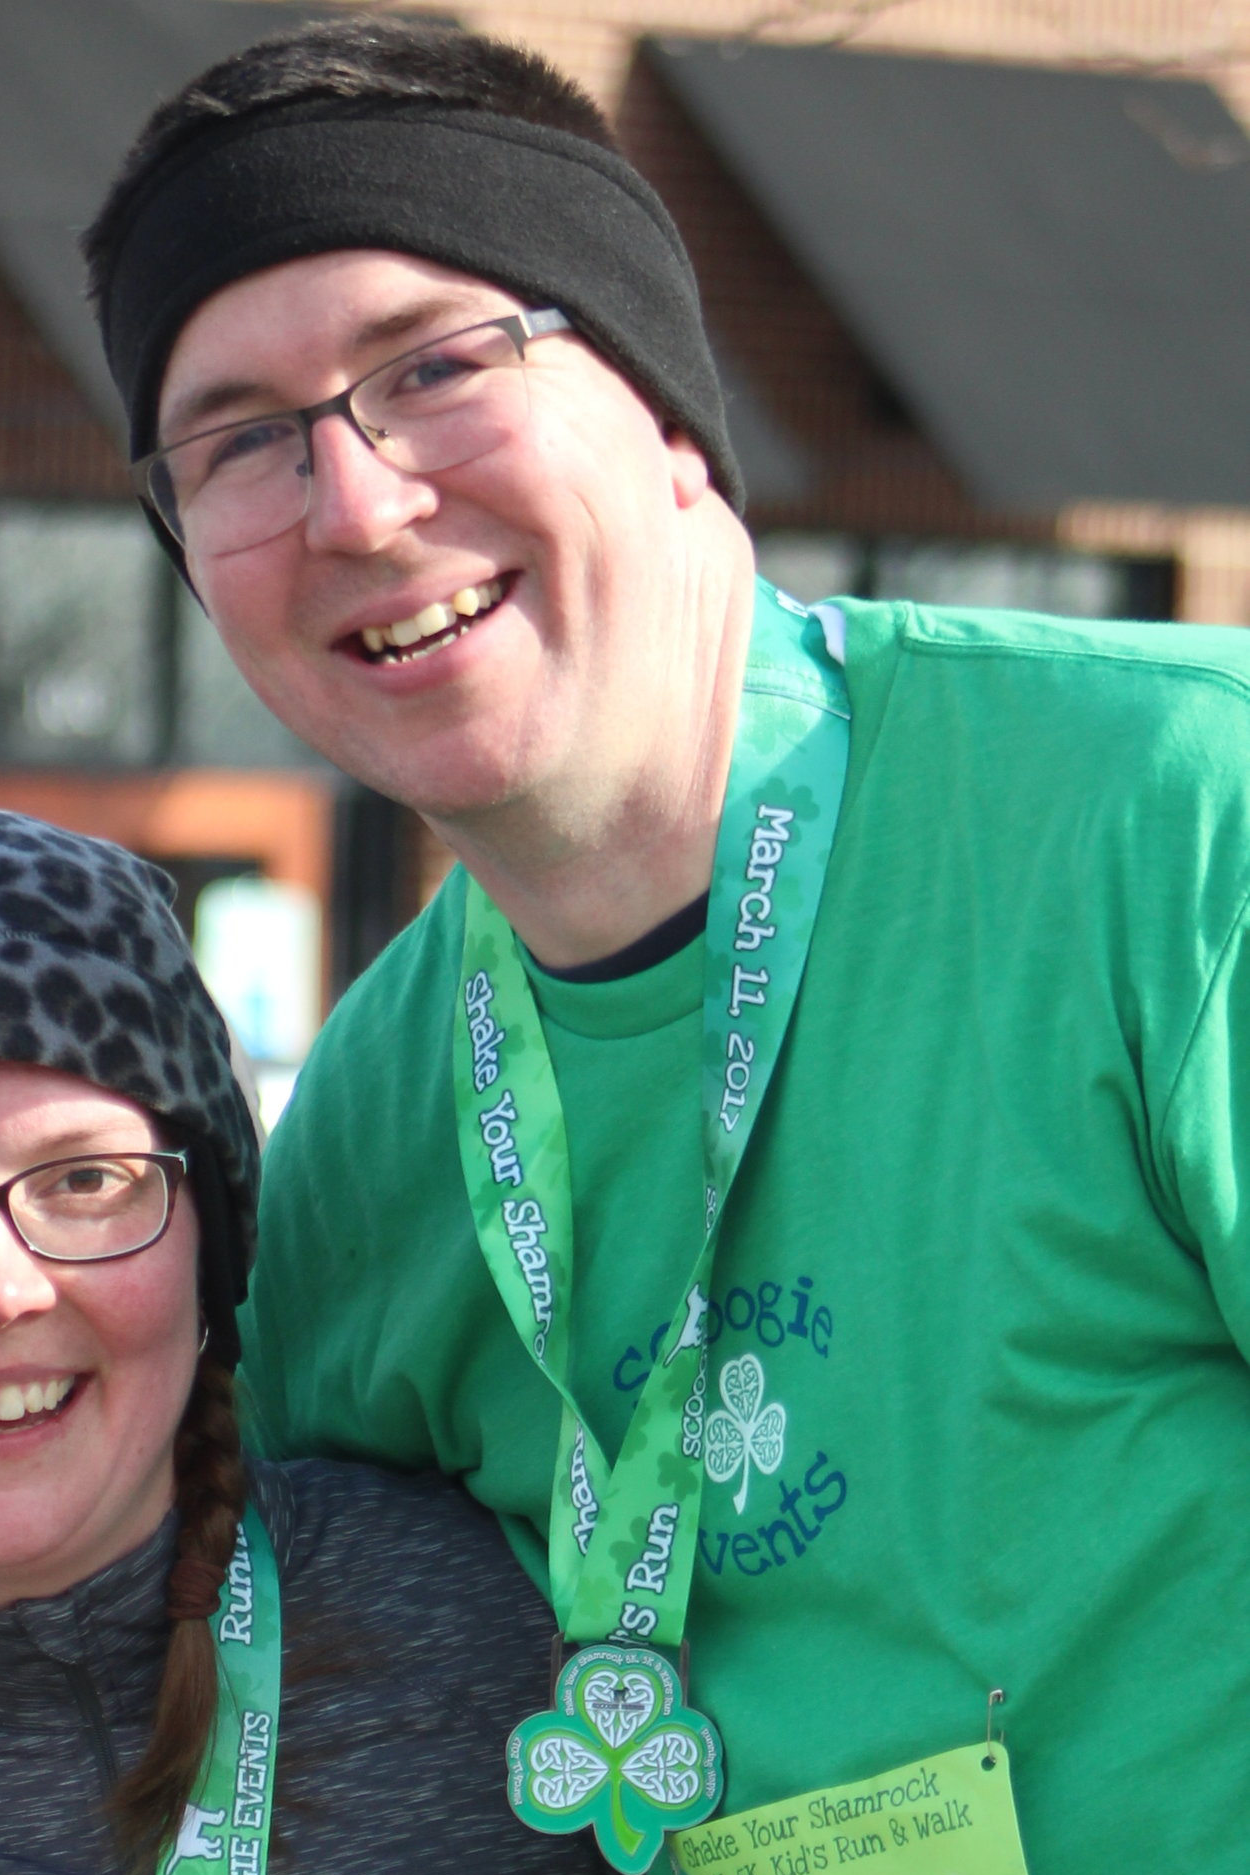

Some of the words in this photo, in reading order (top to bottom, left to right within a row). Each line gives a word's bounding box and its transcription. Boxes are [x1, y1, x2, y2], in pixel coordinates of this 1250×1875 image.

[733, 804, 794, 952] March
[465, 970, 500, 1091] Shake
[729, 962, 770, 1019] 11,
[719, 1034, 755, 1134] 2017
[480, 1090, 523, 1188] Your
[626, 1503, 678, 1594] Run
[699, 1452, 847, 1576] vents
[235, 1712, 272, 1830] EVENTS
[682, 1831, 740, 1868] Shake
[743, 1815, 799, 1850] Your
[808, 1767, 940, 1830] Shamrock
[833, 1834, 886, 1865] Run
[889, 1818, 909, 1847] &
